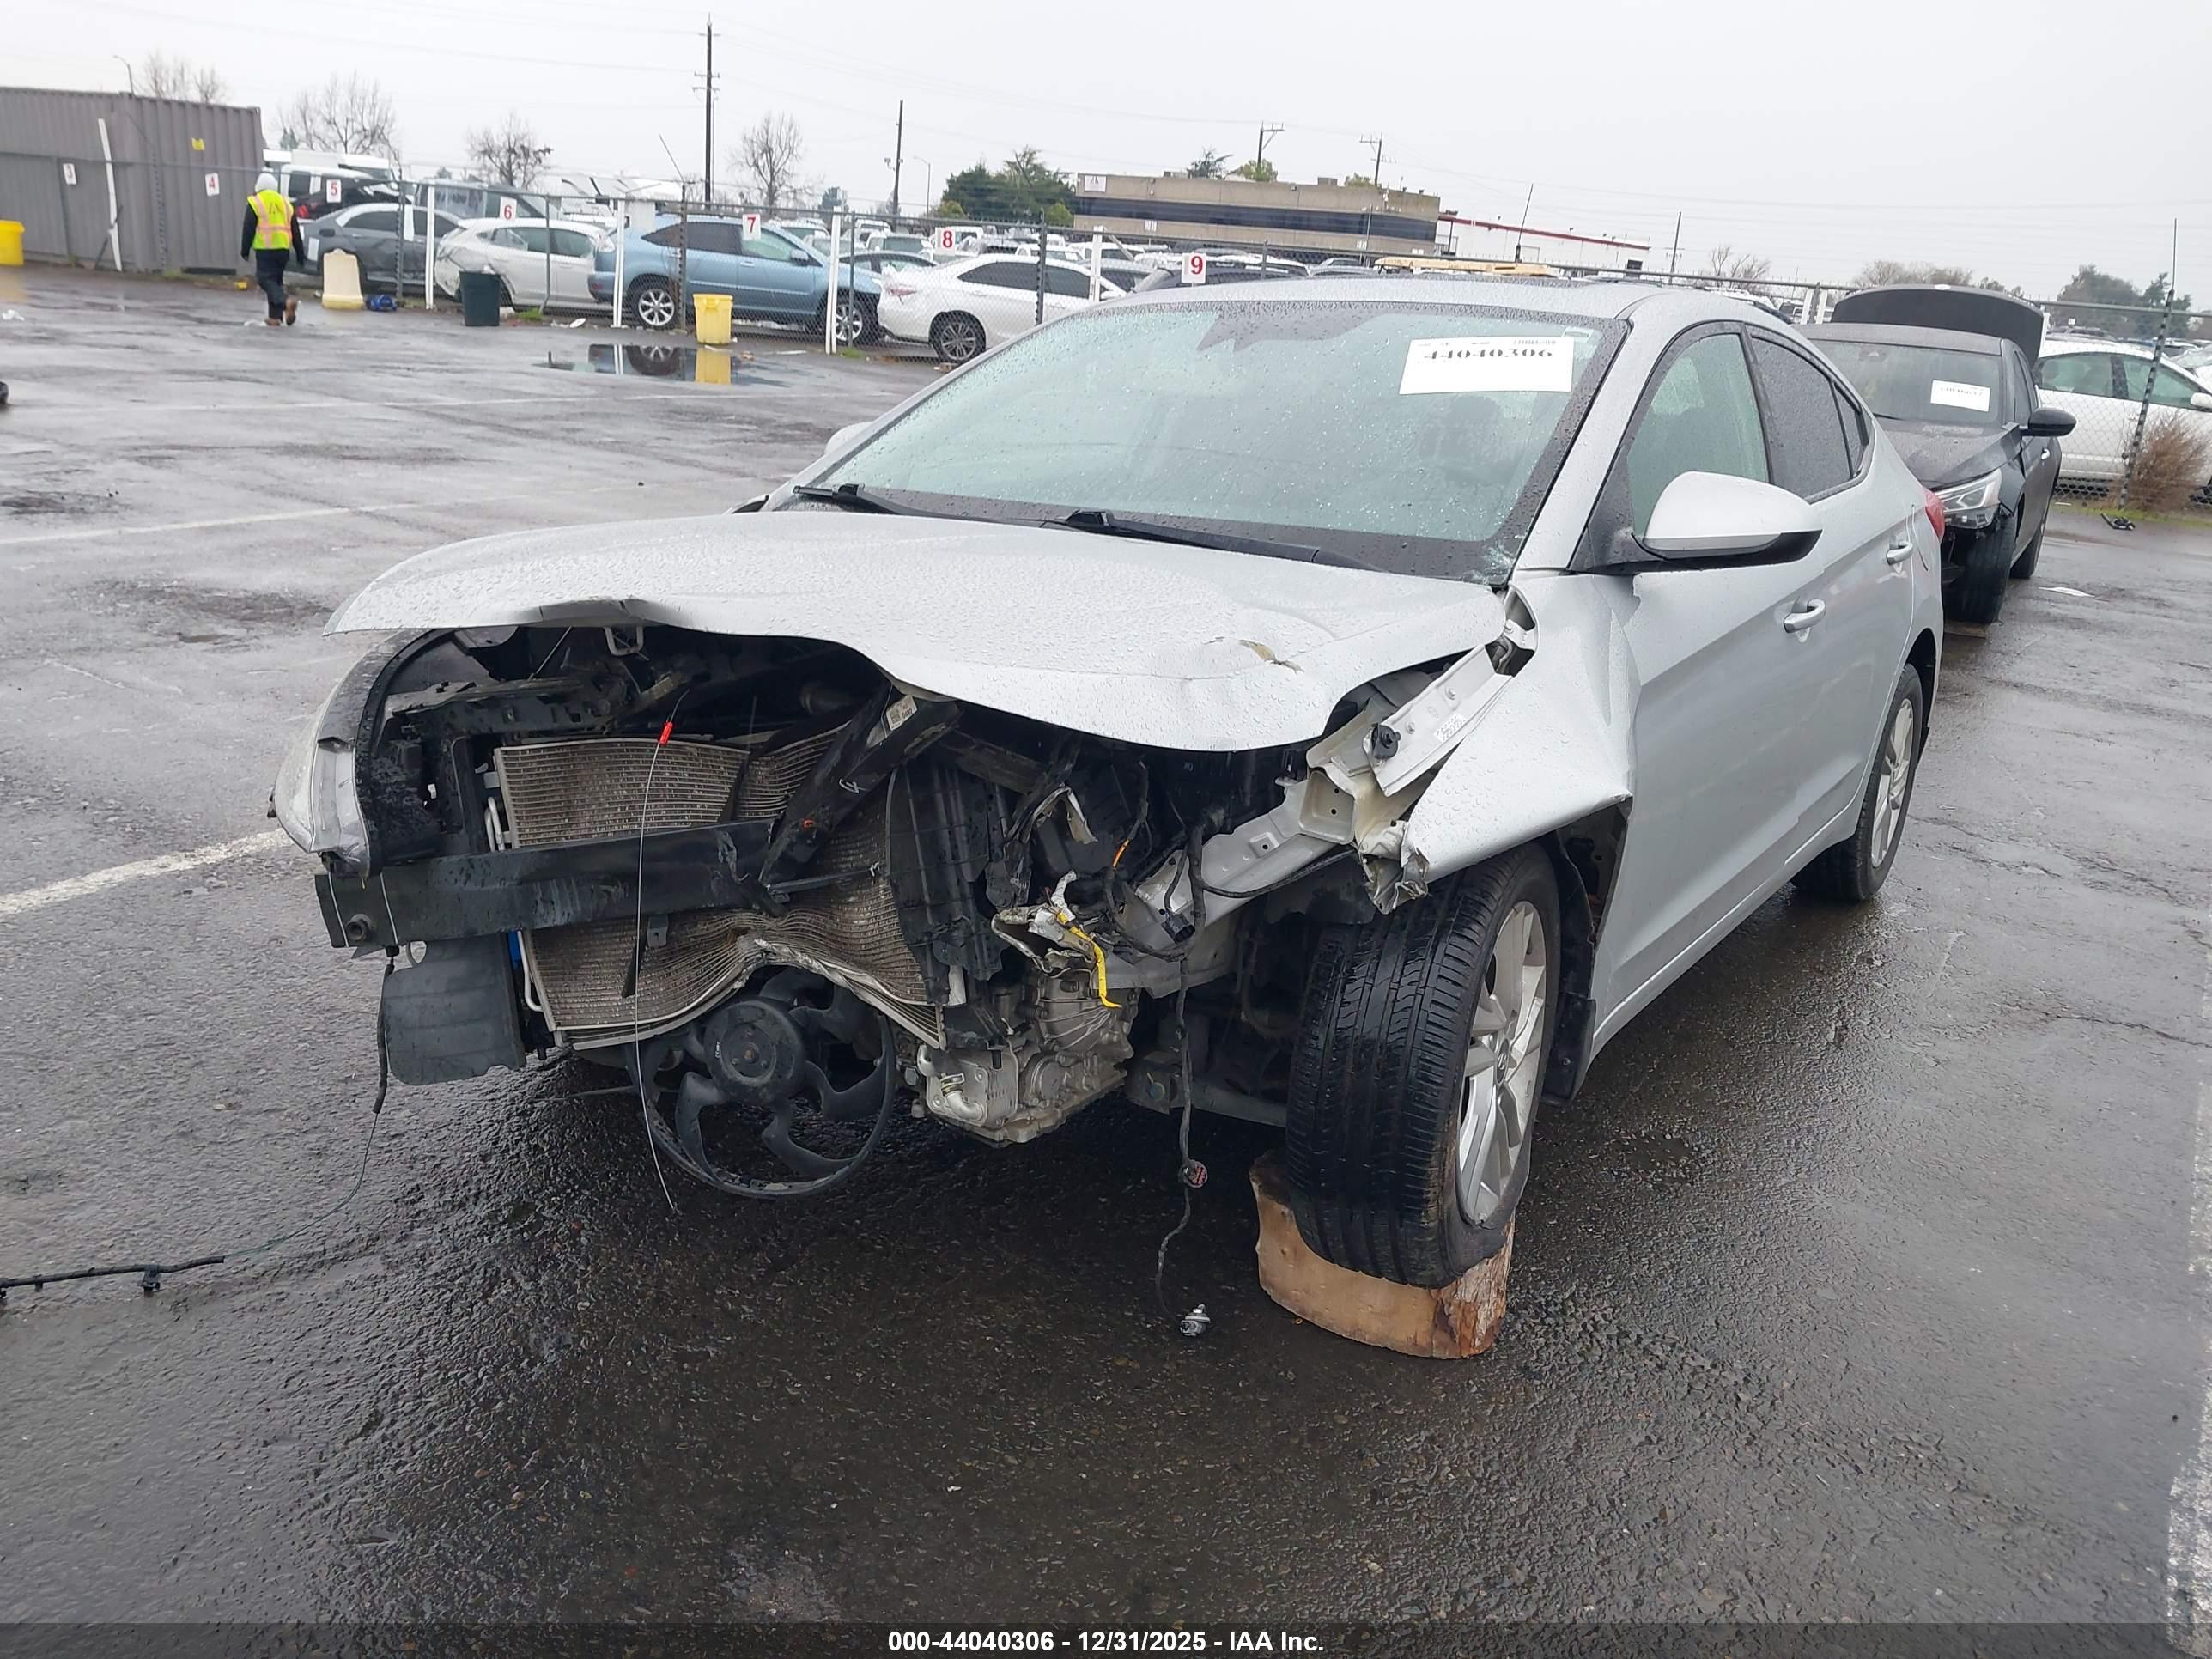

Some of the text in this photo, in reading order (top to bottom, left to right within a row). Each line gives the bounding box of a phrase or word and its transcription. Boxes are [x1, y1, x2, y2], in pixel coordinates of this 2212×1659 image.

[209, 176, 216, 189] 4
[331, 182, 338, 197] 5
[504, 204, 513, 220] 6
[746, 217, 757, 234] 7
[942, 230, 953, 248] 8
[1190, 255, 1204, 275] 9
